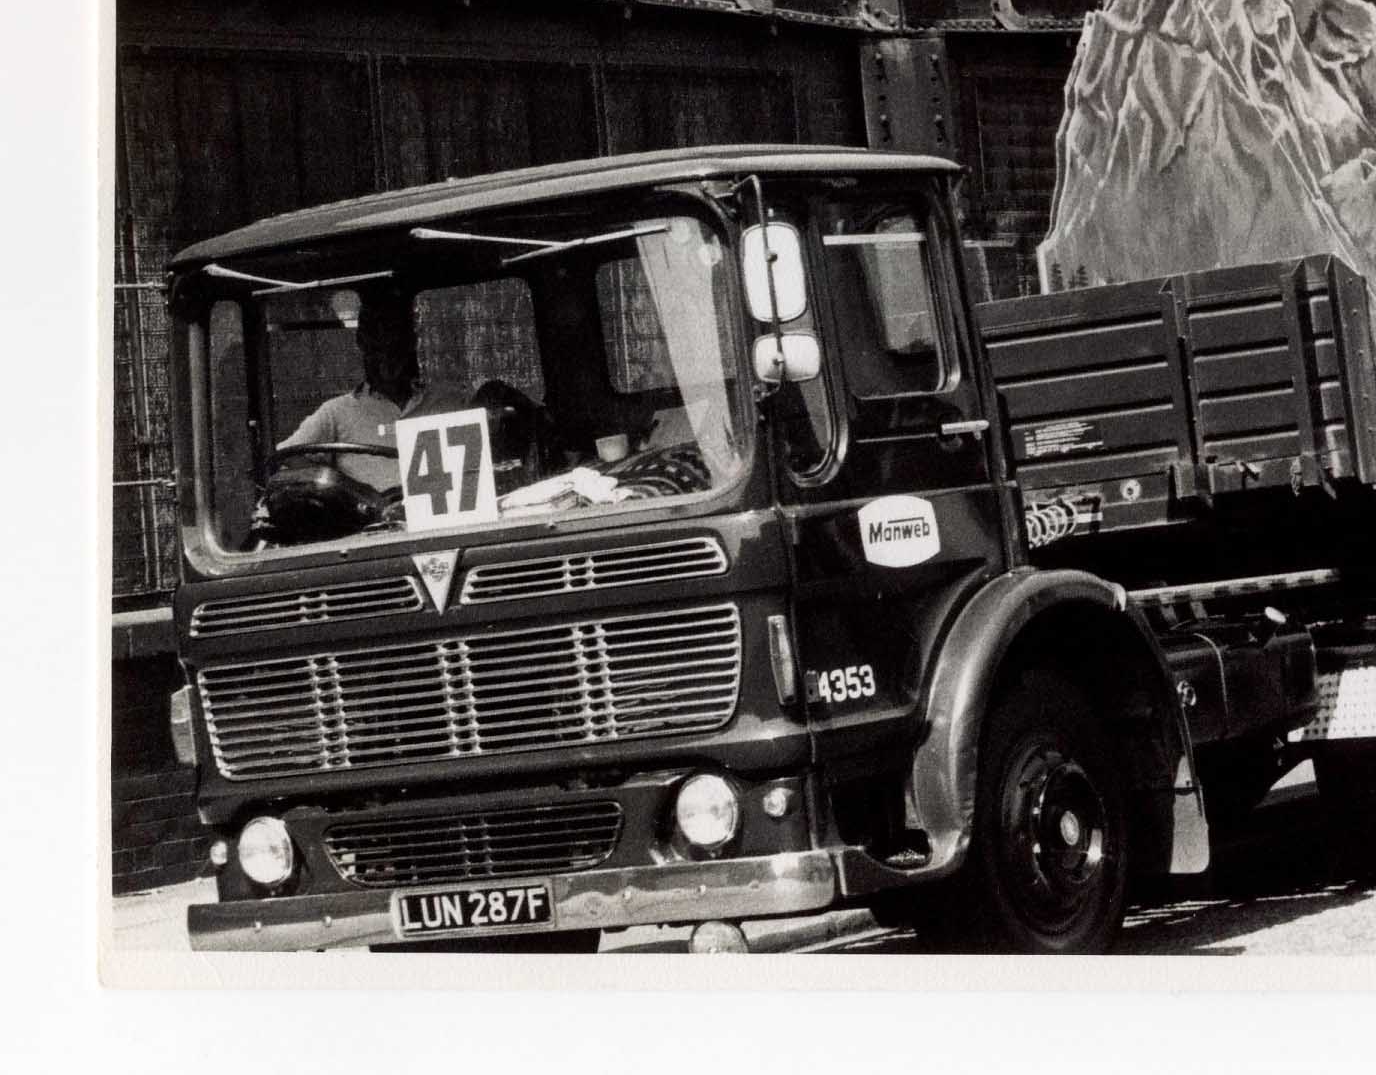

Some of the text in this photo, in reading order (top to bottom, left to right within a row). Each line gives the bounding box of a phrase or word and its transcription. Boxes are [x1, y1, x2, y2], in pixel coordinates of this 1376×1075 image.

[406, 422, 483, 516] 47
[869, 516, 931, 544] Manweb
[818, 664, 876, 703] 4353
[401, 887, 546, 930] LUN 287F
